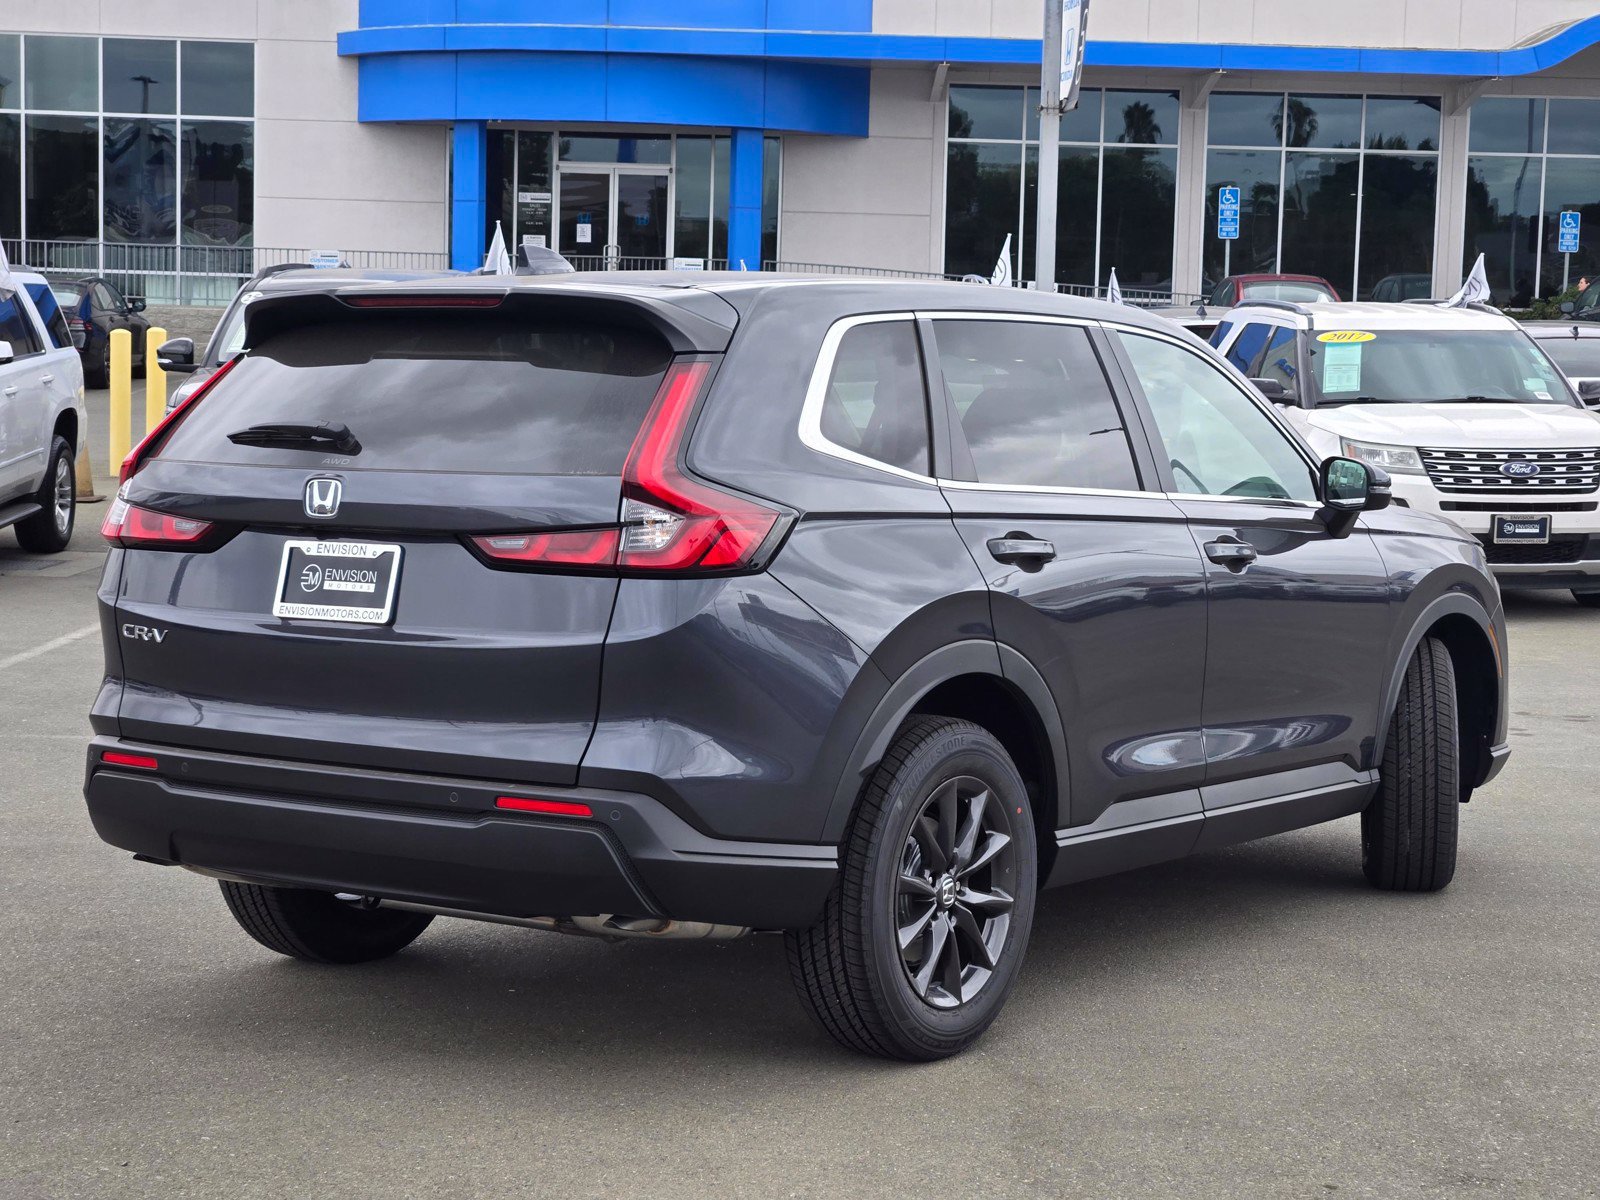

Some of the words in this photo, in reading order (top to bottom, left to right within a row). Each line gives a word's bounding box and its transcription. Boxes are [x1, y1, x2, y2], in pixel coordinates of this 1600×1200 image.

[1328, 333, 1366, 341] 2017
[1510, 463, 1532, 474] Ford
[316, 543, 368, 556] ENVISION
[324, 568, 378, 583] ENVISION
[327, 582, 372, 591] MOTORS
[278, 605, 383, 620] ENVISIONMOTORS.COM
[122, 623, 169, 643] CR-V
